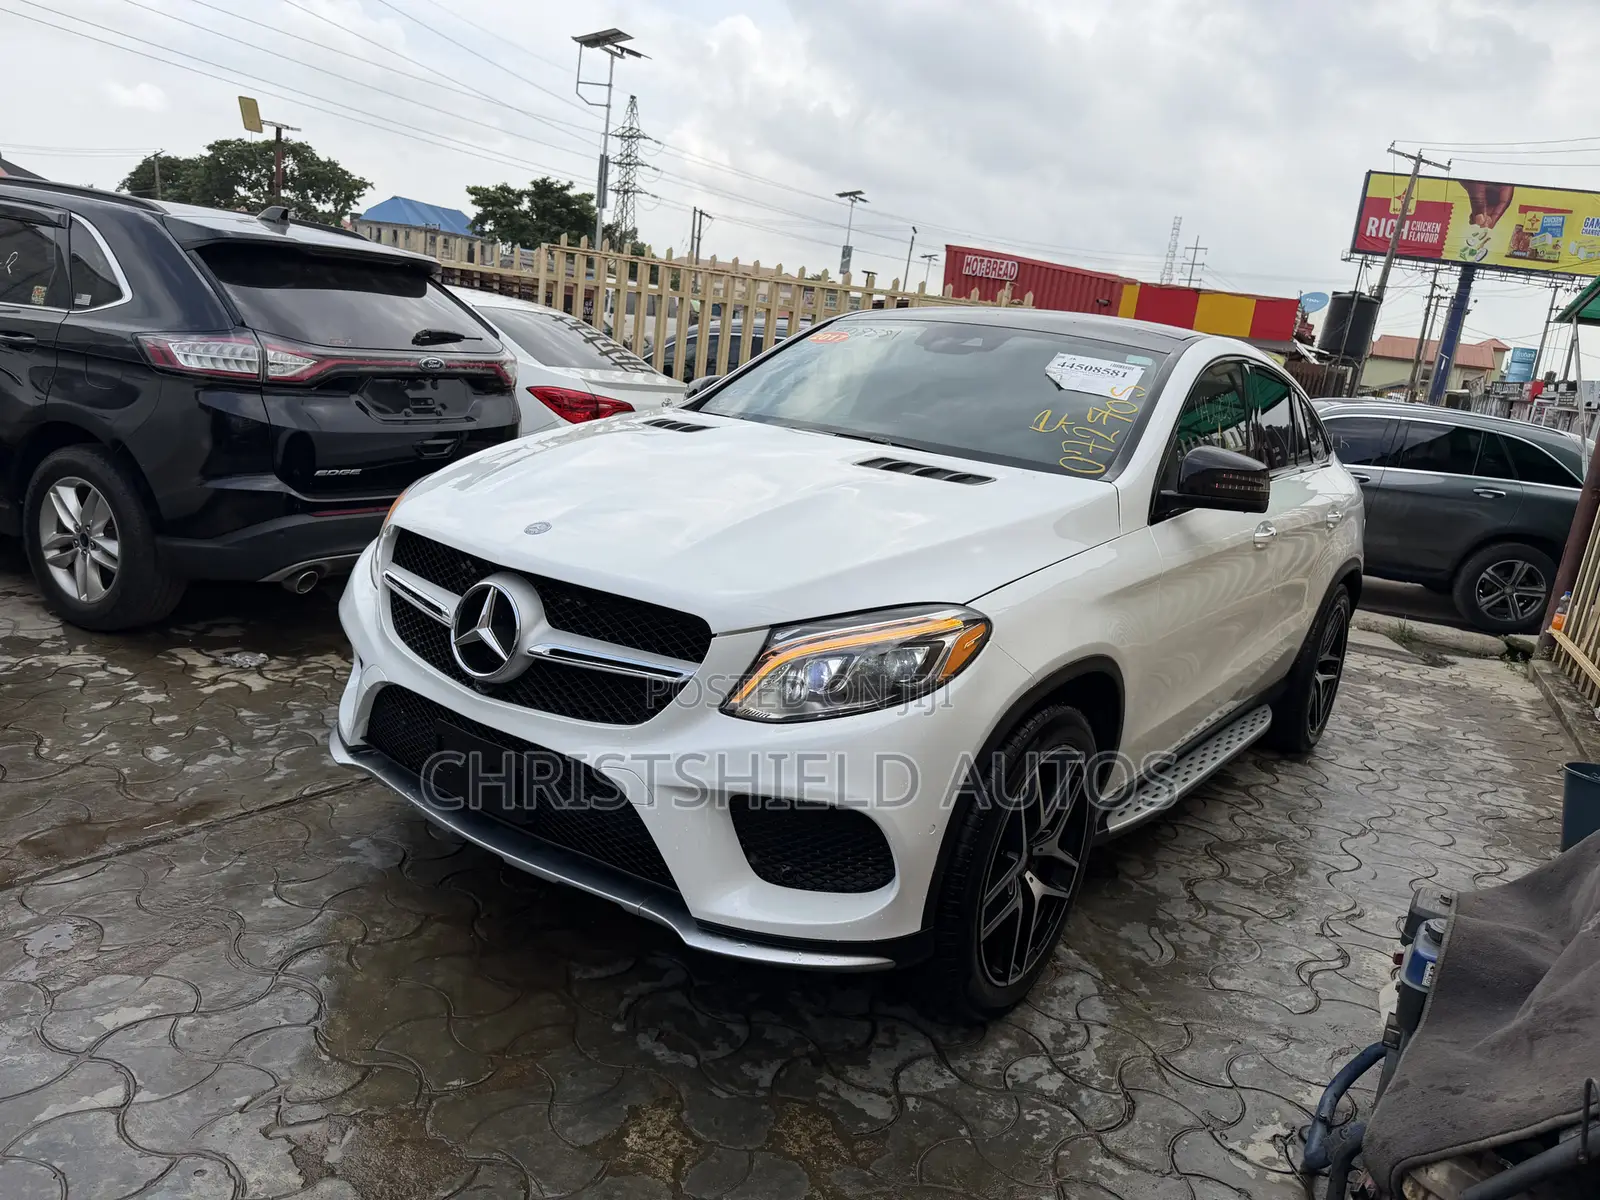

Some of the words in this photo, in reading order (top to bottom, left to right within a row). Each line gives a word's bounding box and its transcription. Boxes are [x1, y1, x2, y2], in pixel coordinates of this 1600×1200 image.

[1365, 216, 1410, 240] RICH
[1410, 220, 1442, 234] CHICKEN
[1408, 231, 1439, 244] FLAVOUR
[811, 331, 848, 342] 2017
[1057, 361, 1128, 378] 44508581
